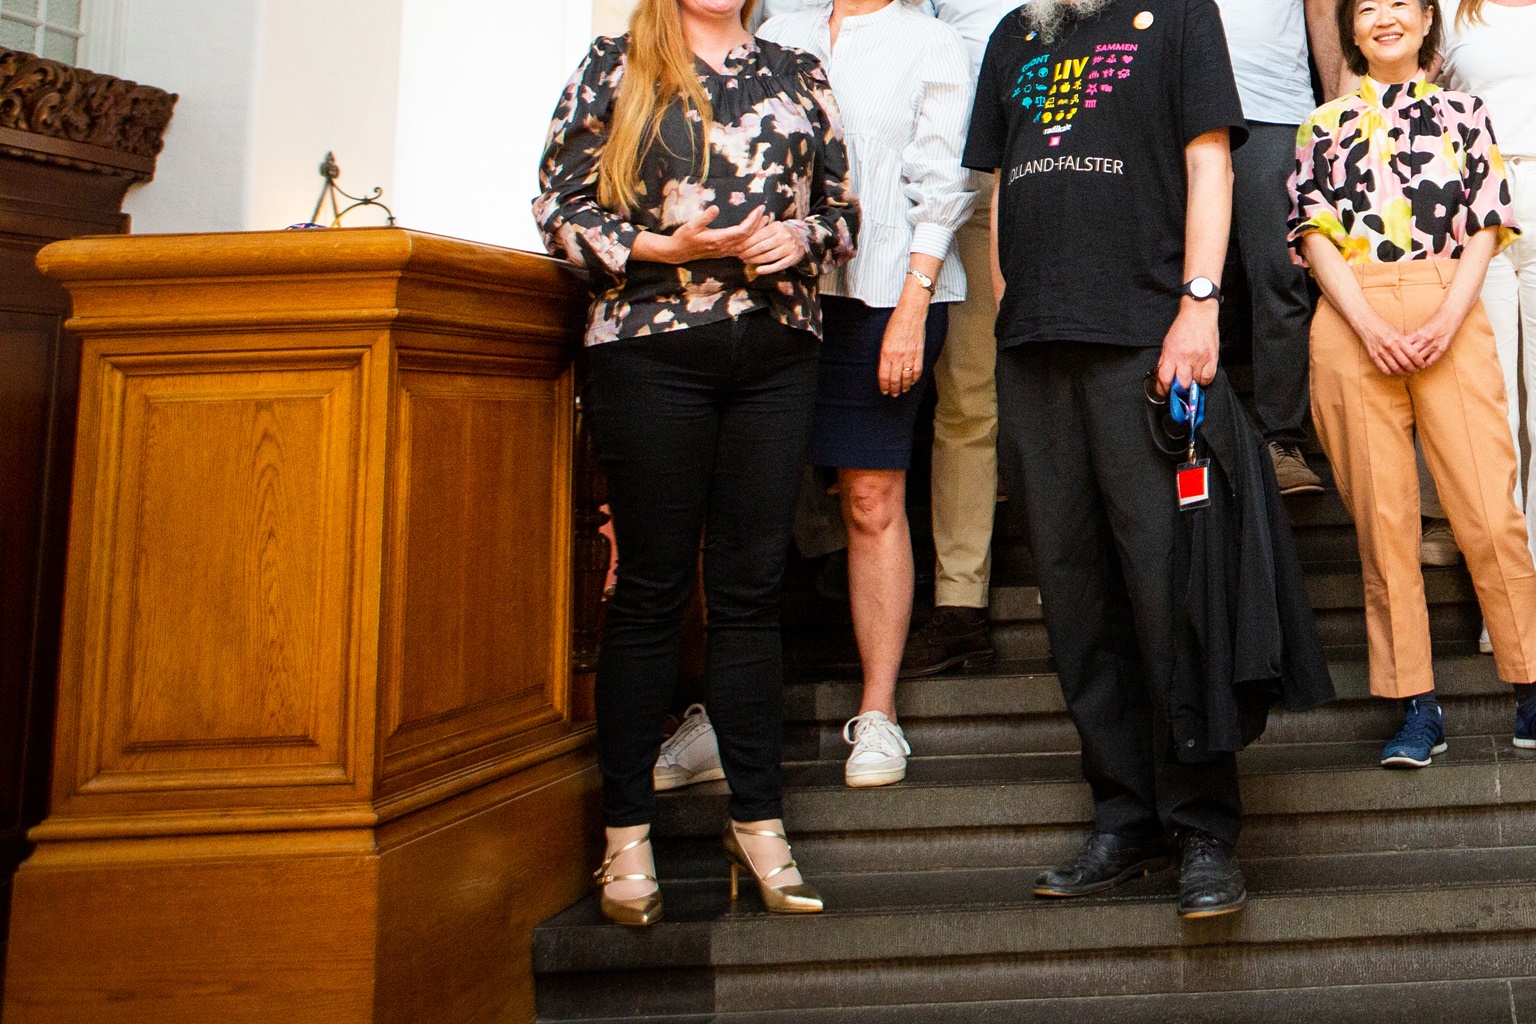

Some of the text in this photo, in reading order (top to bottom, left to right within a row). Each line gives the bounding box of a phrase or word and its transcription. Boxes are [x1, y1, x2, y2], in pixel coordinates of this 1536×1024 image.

[1095, 43, 1138, 52] SAMMEN
[1054, 56, 1089, 82] LIV
[1008, 156, 1124, 185] OLLAND-FALSTER
